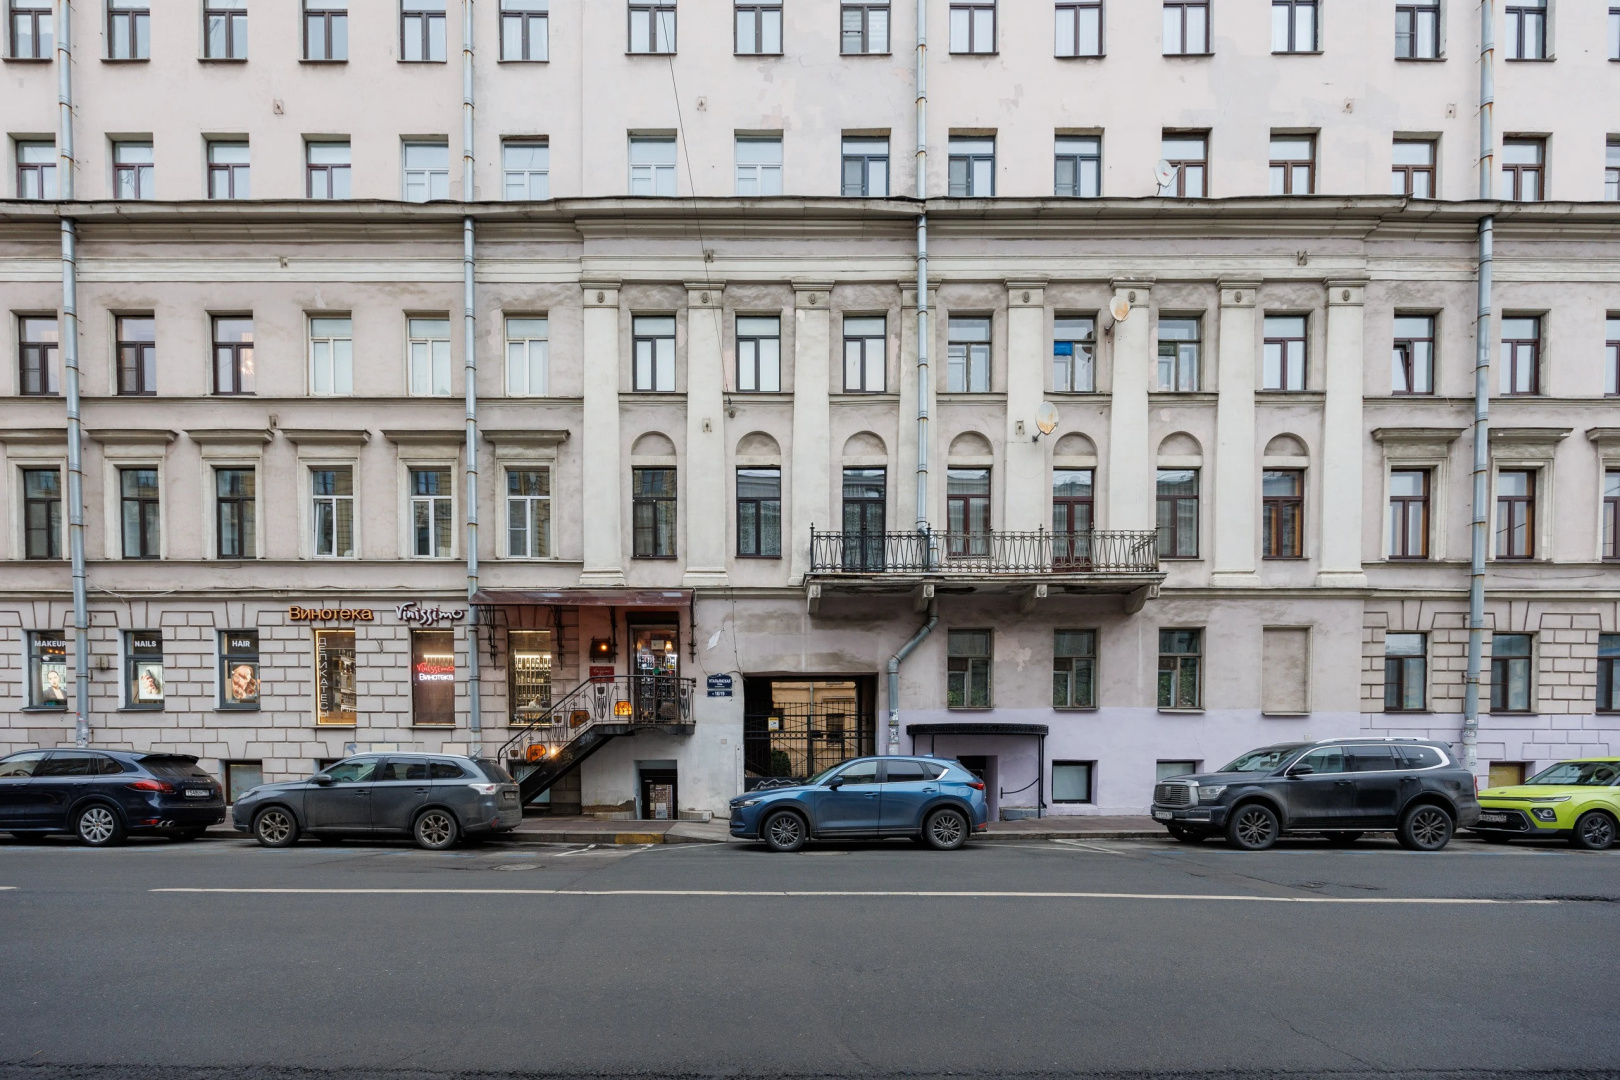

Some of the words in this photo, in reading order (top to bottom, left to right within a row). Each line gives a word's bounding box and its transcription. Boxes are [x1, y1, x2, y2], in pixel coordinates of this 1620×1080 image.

[289, 606, 374, 621] Винотека
[395, 601, 463, 625] Vinissimo
[416, 662, 455, 674] Vinissimo
[319, 637, 329, 717] ДЕЛИКАТЕСЫ
[418, 673, 454, 681] Винотека
